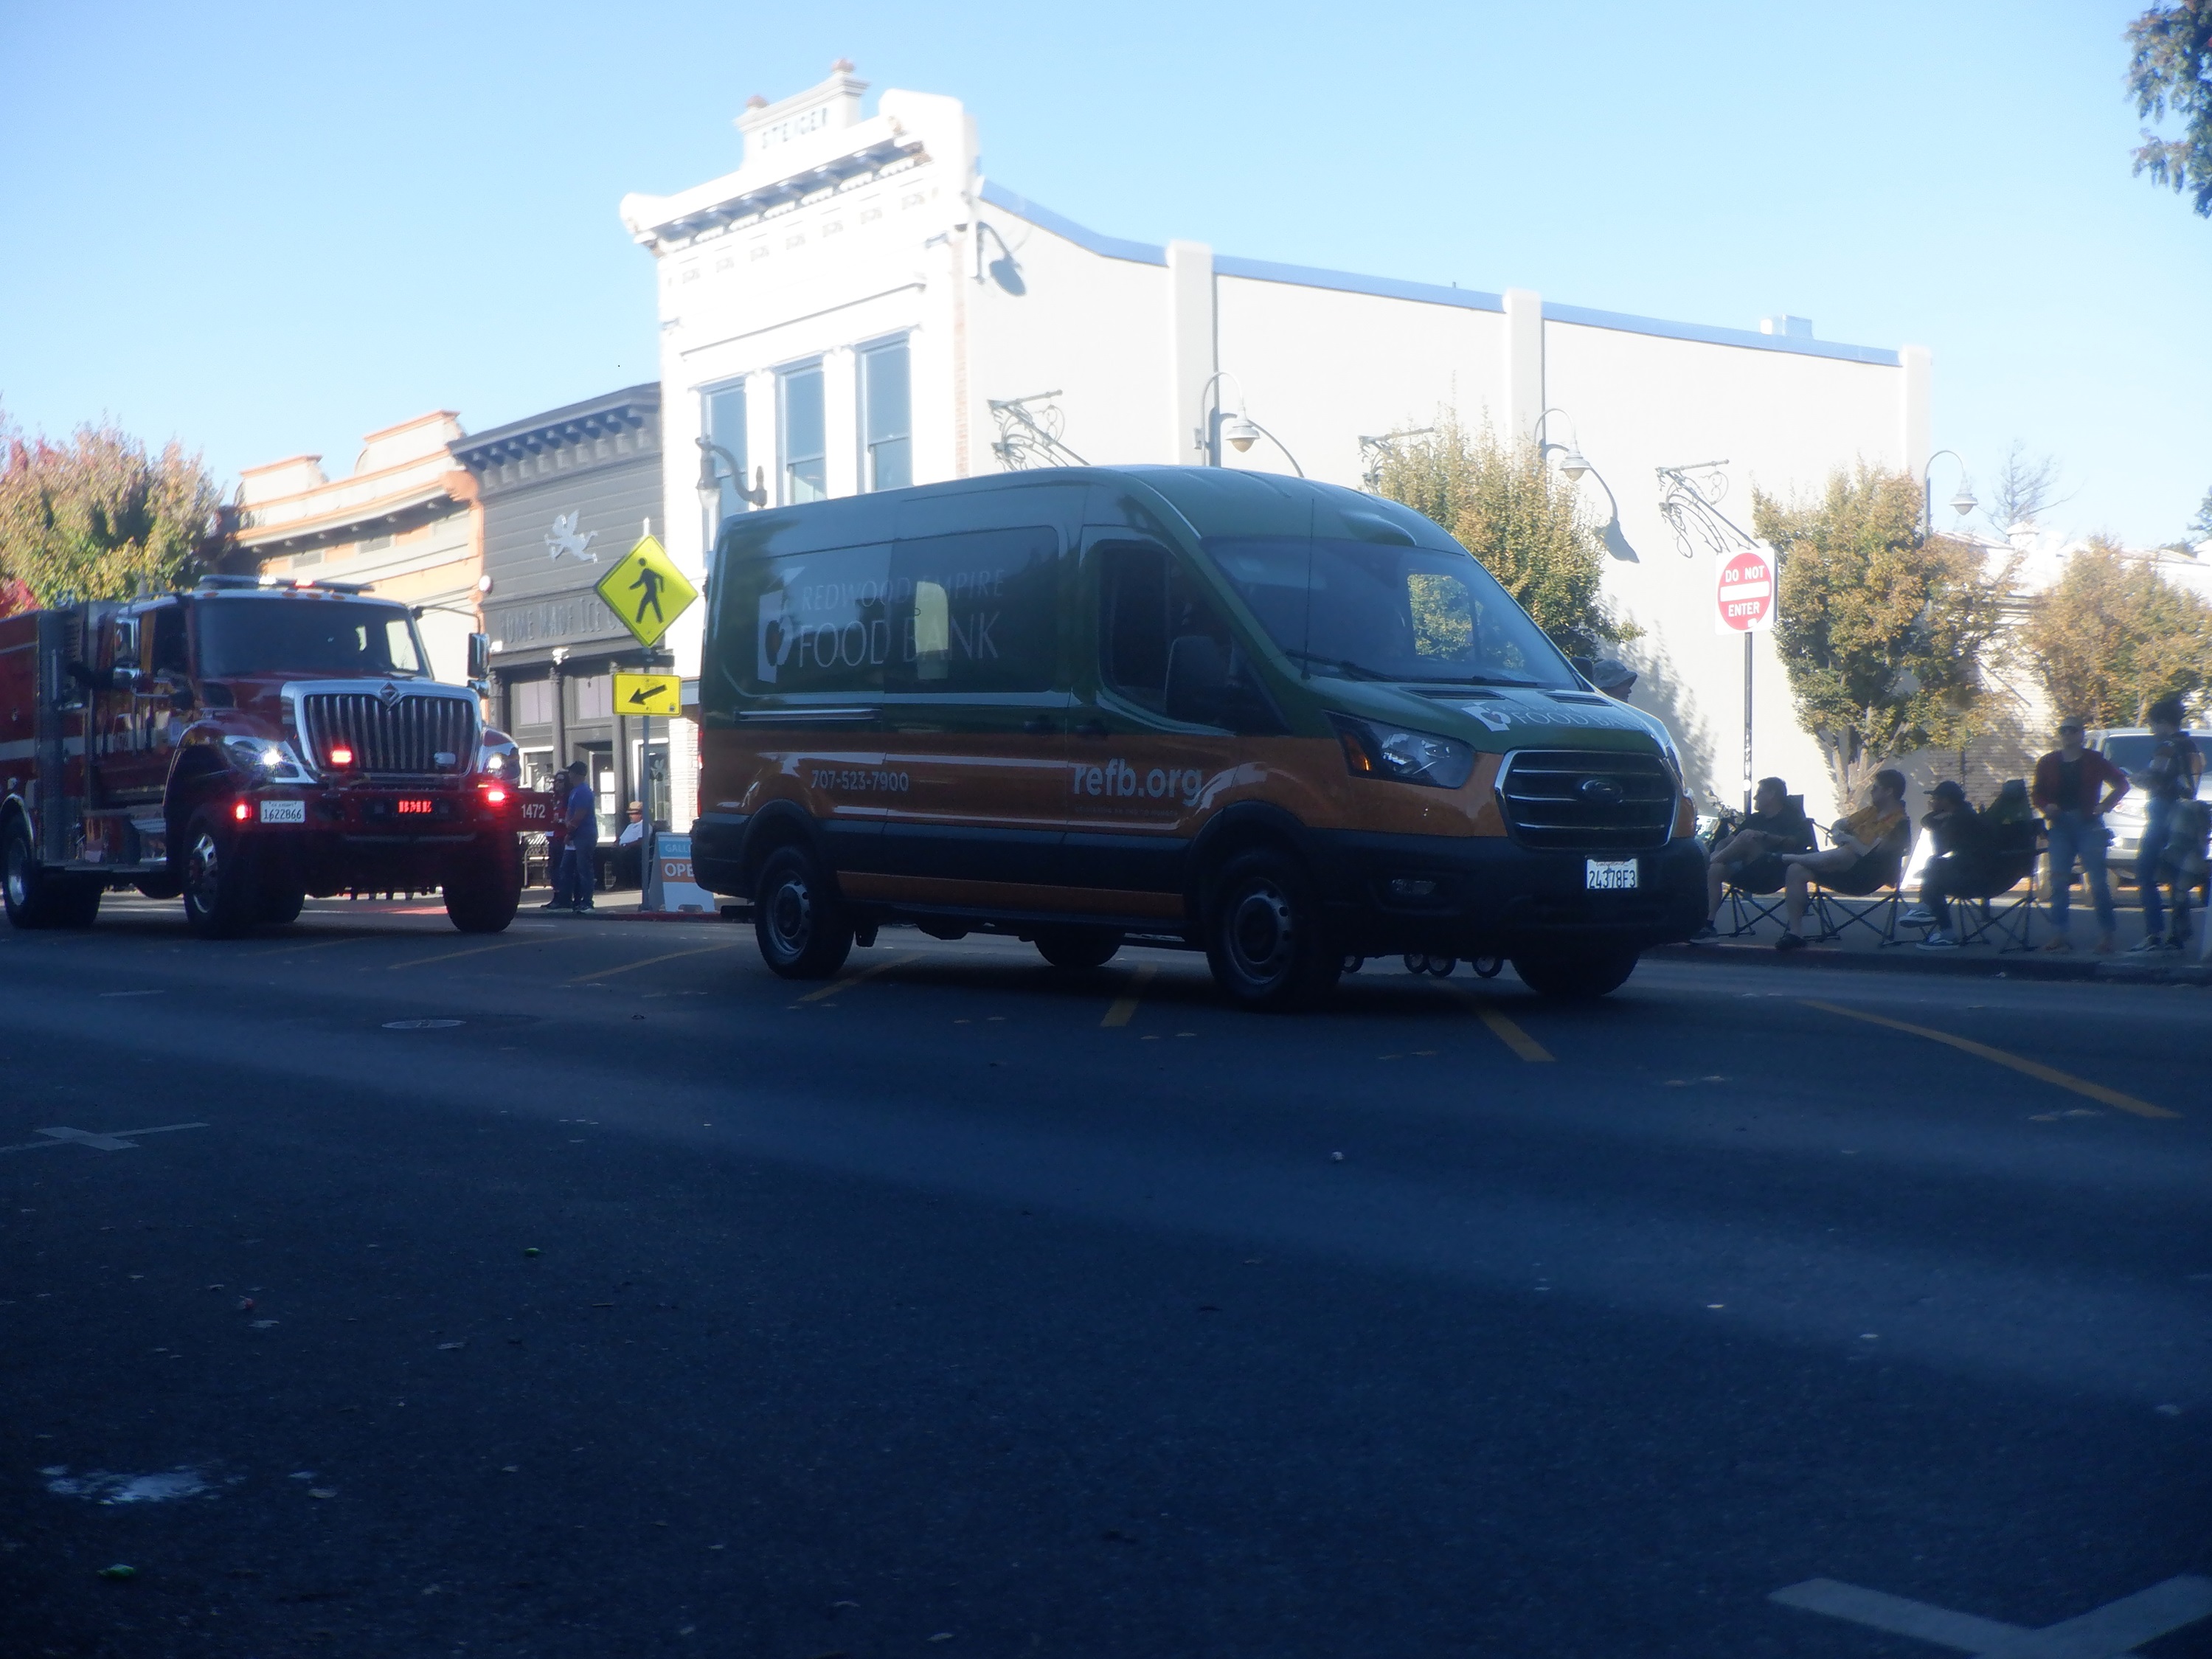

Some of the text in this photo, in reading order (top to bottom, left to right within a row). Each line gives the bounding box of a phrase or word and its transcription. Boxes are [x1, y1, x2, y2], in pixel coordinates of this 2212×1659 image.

[1725, 565, 1764, 583] DO NOT
[802, 577, 912, 611] REDWOOD
[1728, 601, 1761, 617] ENTER
[799, 612, 999, 668] FOOD BANK
[1514, 712, 1589, 725] FOOD
[811, 769, 909, 792] 707-523-7900
[1072, 757, 1203, 807] refb.org
[264, 808, 302, 820] 1622866
[521, 804, 546, 819] 1472
[665, 844, 689, 853] GALL
[665, 863, 695, 877] OPE
[1589, 870, 1636, 889] 24378F3
